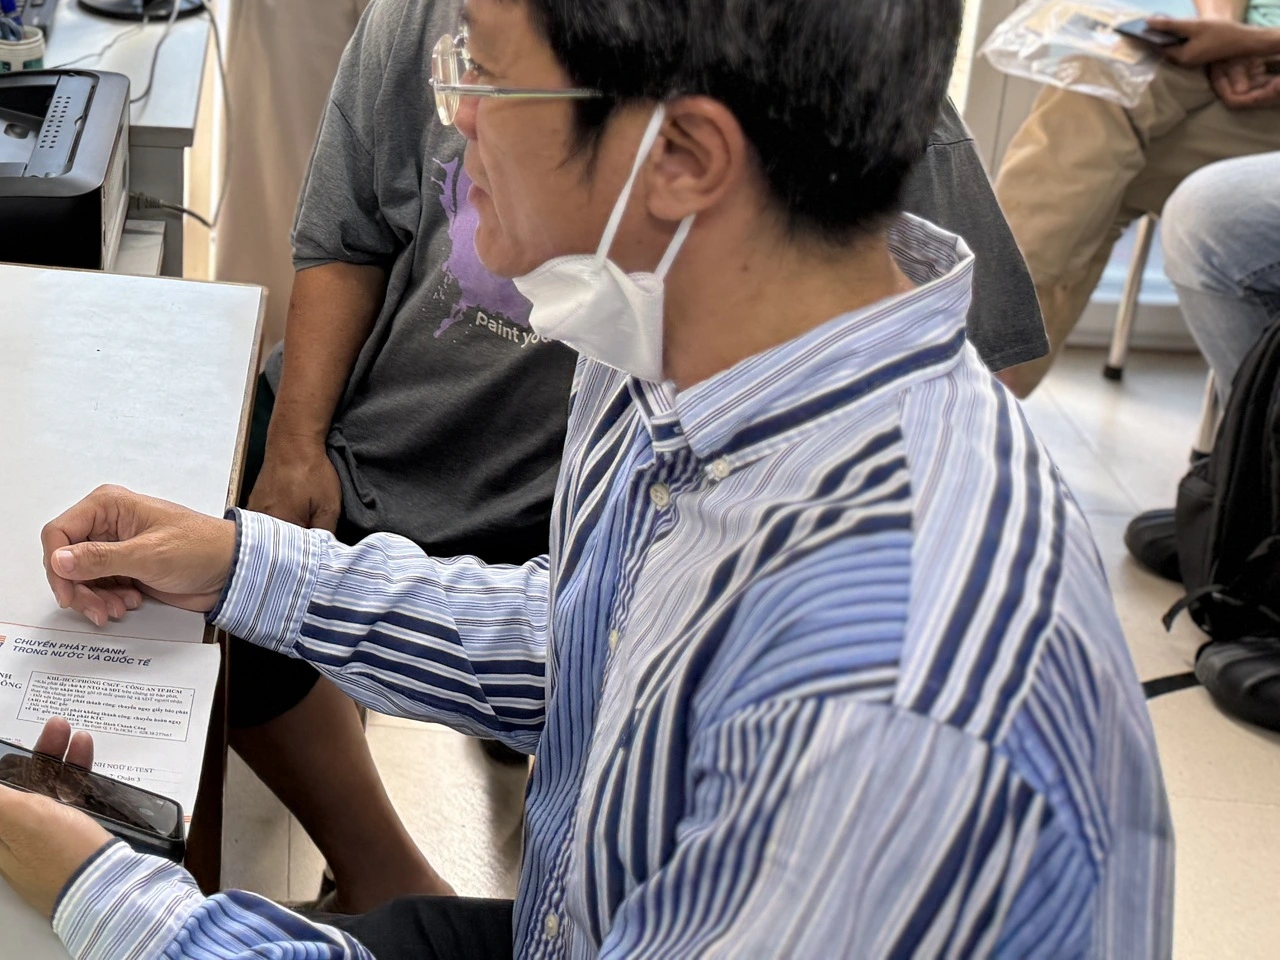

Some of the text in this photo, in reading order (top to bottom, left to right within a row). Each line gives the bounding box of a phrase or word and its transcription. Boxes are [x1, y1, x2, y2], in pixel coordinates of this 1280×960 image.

[475, 311, 519, 343] paint
[11, 645, 49, 655] TRONG
[50, 648, 84, 659] NƯỚC
[102, 653, 134, 664] QUỐC
[136, 656, 152, 666] TẾ
[13, 636, 125, 655] CHUYỂN PHÁT NHANH
